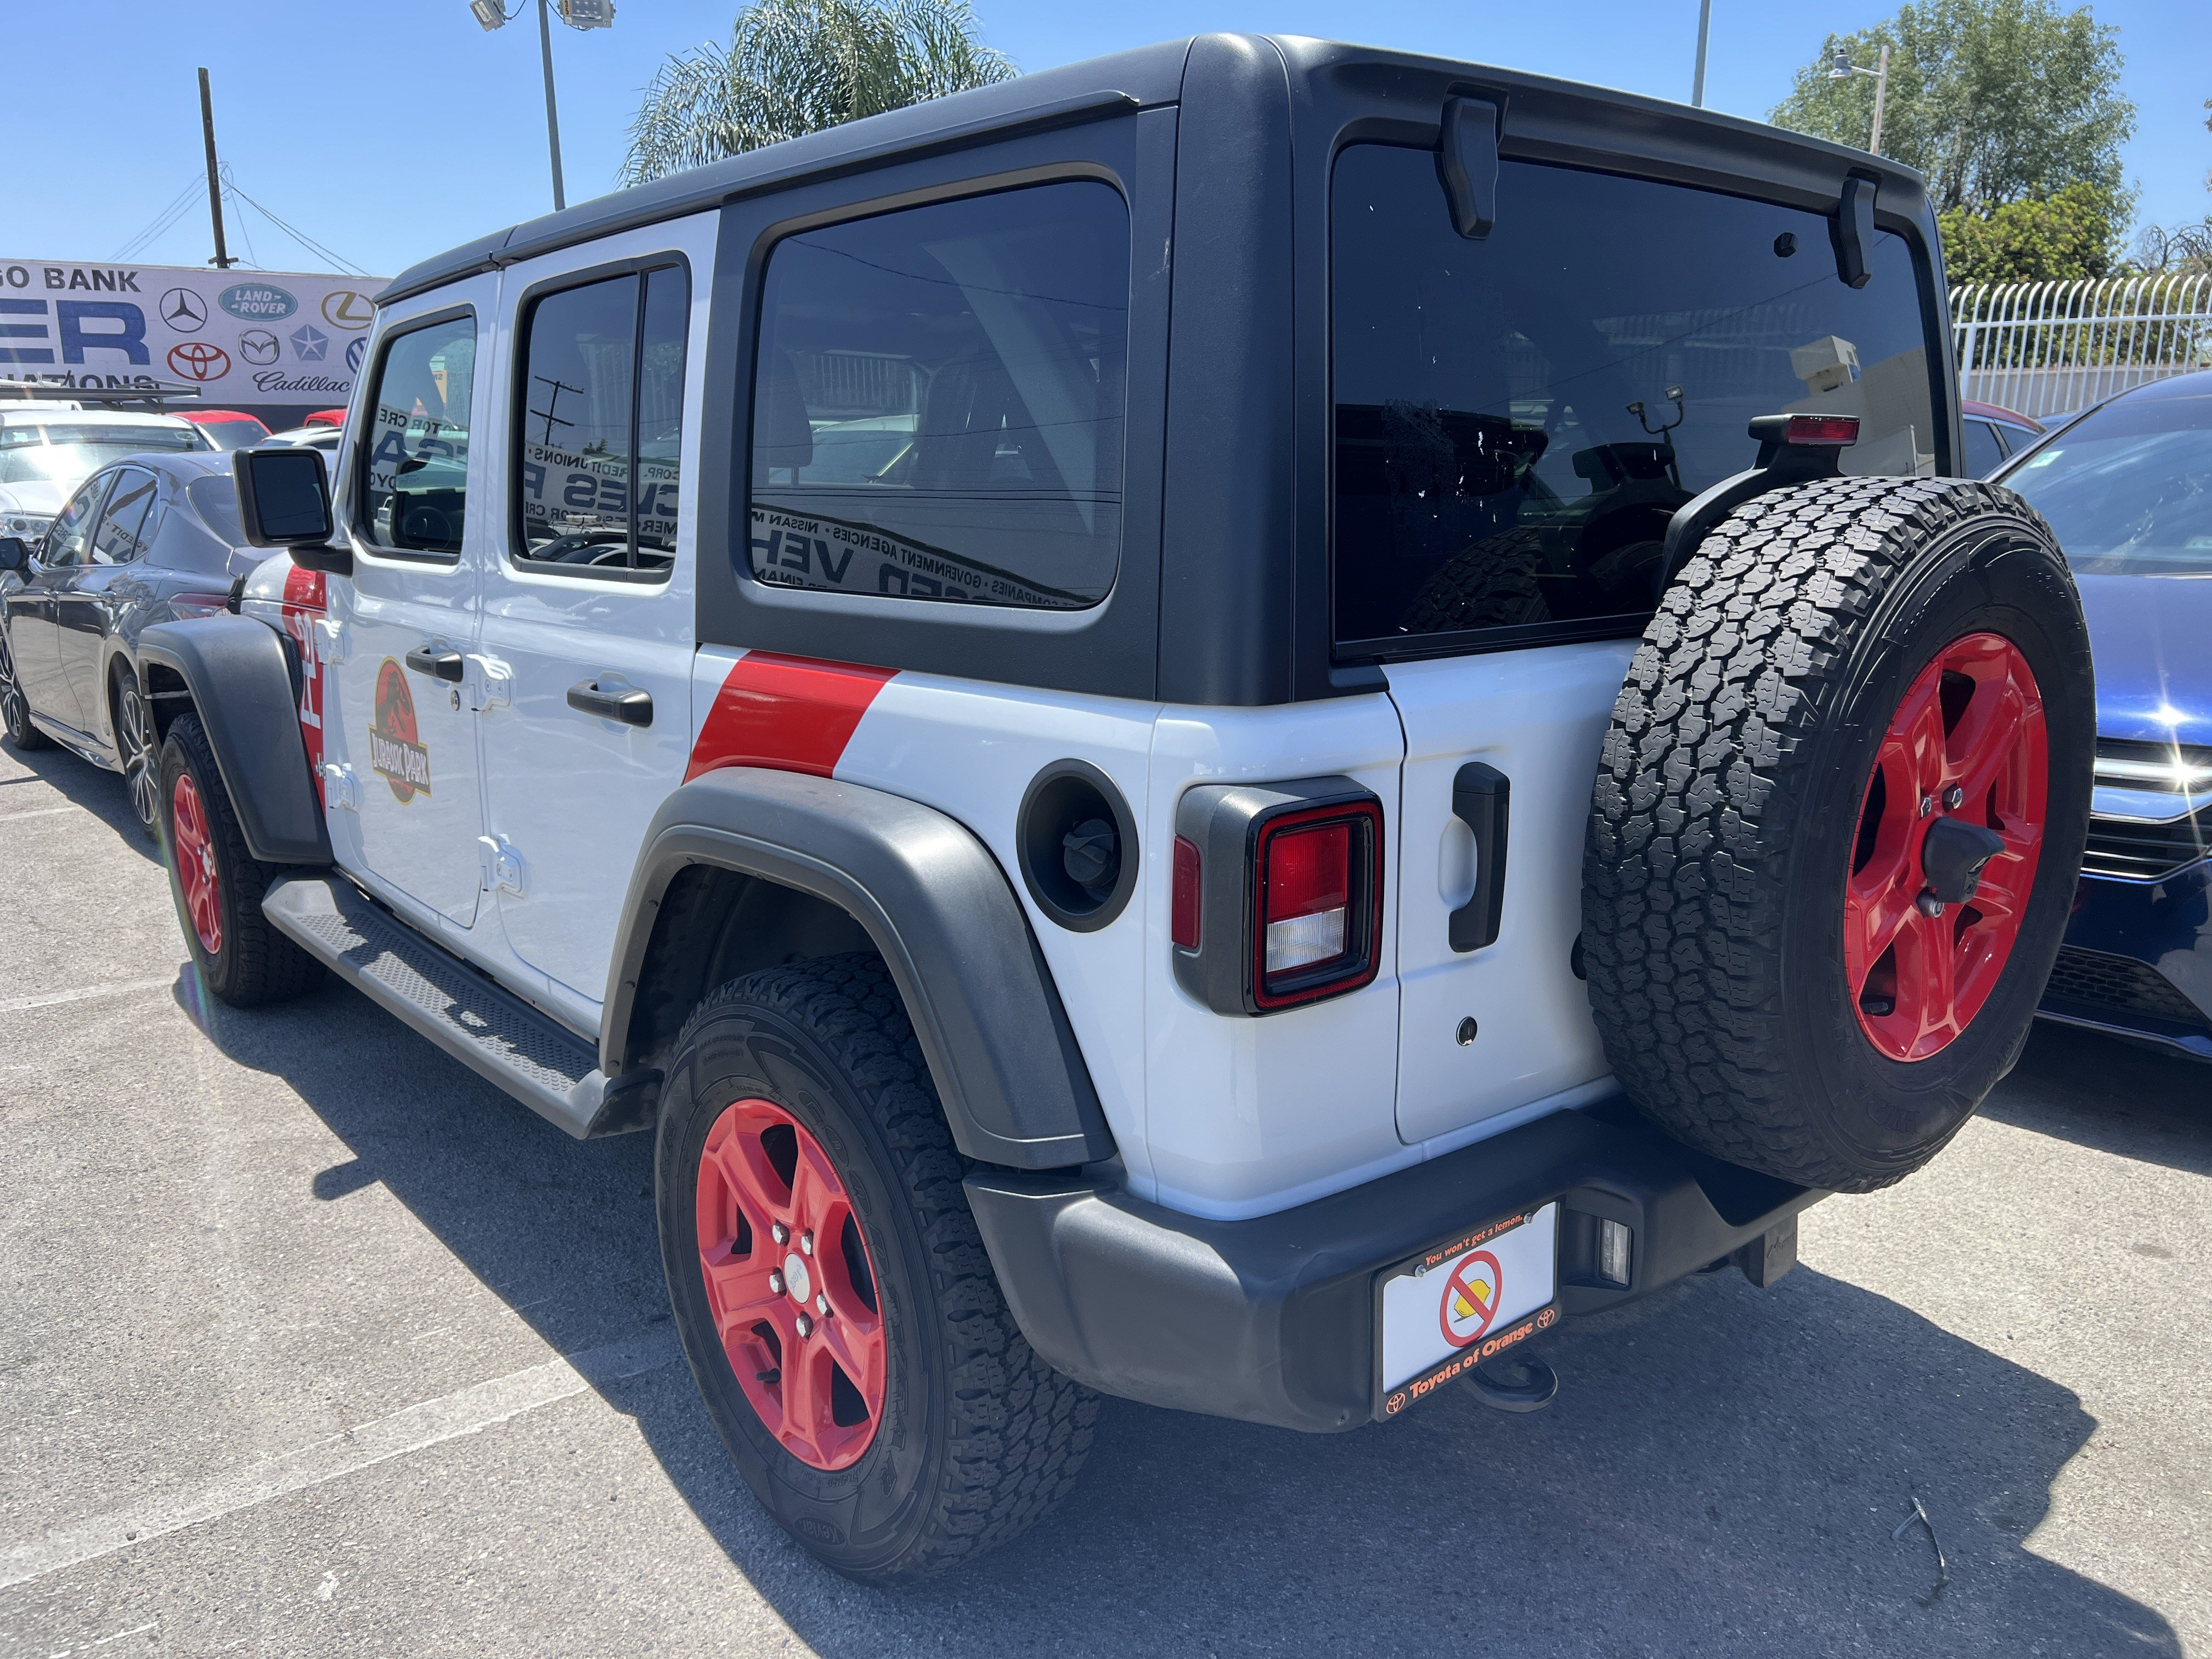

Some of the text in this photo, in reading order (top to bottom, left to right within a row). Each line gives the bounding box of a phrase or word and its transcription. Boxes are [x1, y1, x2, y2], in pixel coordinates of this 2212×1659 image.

[44, 267, 142, 292] BANK
[252, 371, 351, 392] Cadillac
[371, 732, 429, 786] JURASSIC PARK
[1425, 1214, 1523, 1266] You won't get a lemon.
[789, 1263, 802, 1294] Jeep
[1409, 1322, 1534, 1399] Toyota of Orange
